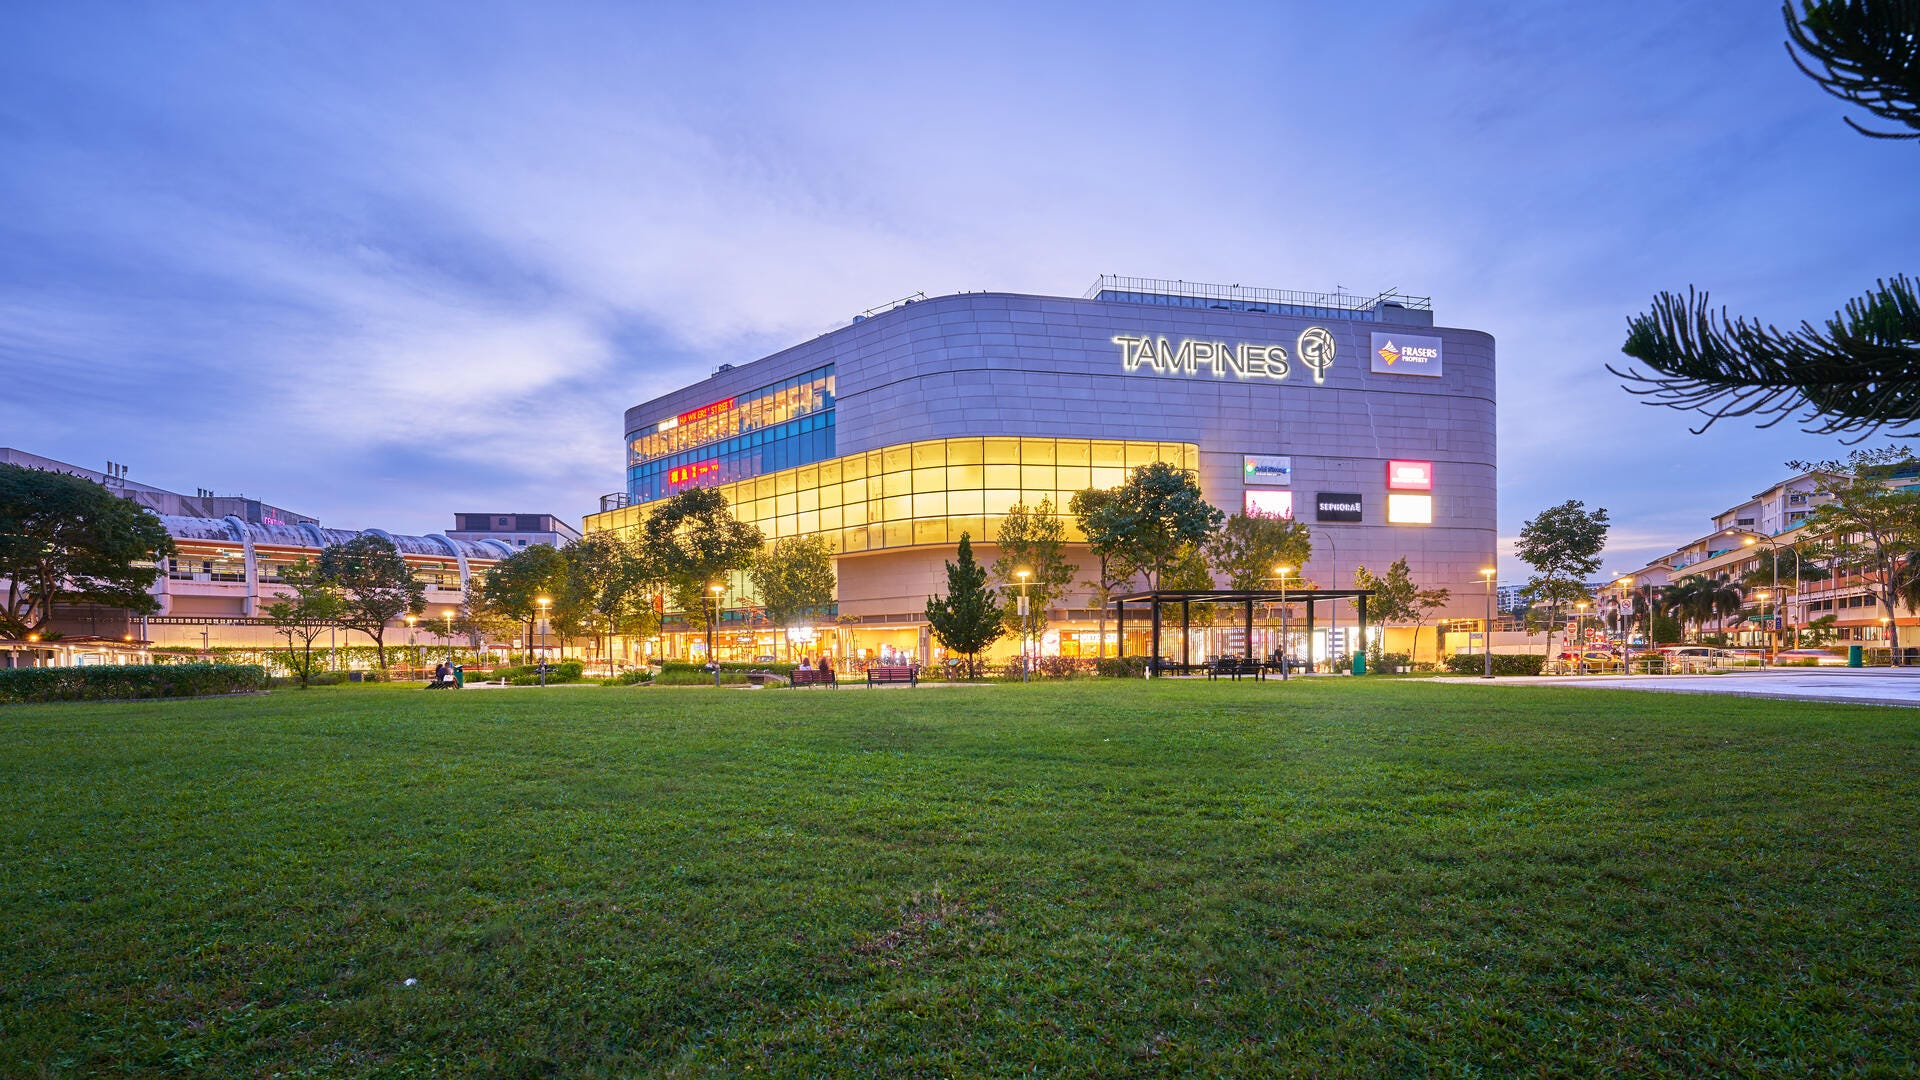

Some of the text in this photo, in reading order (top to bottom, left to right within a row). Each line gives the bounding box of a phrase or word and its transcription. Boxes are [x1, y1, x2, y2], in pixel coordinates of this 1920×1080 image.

[1115, 337, 1290, 377] TAMPINES
[1401, 346, 1437, 358] FRASERS
[711, 400, 734, 414] STREET
[1319, 503, 1355, 511] SEPHORA
